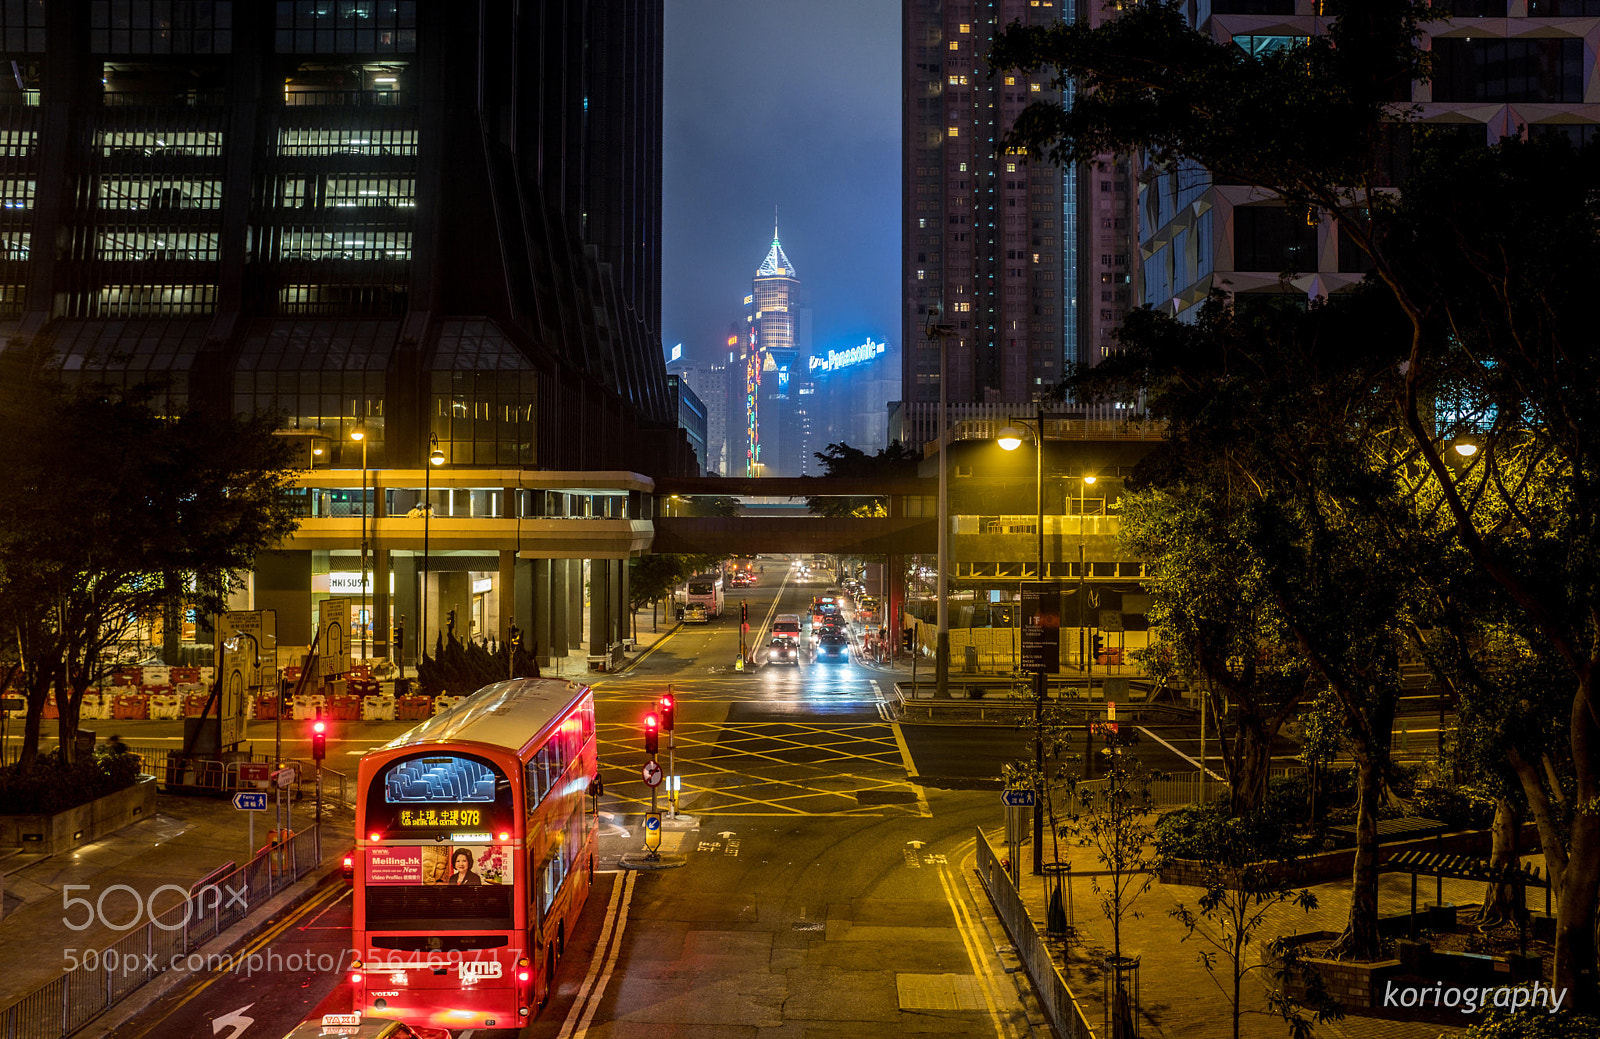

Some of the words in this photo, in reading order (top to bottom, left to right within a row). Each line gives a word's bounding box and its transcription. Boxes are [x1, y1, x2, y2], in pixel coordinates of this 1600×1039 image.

[828, 337, 876, 371] Panasonic
[460, 810, 480, 826] 978
[372, 857, 420, 867] Meiling.hk
[458, 961, 503, 980] KMB
[325, 1016, 356, 1024] TAXI
